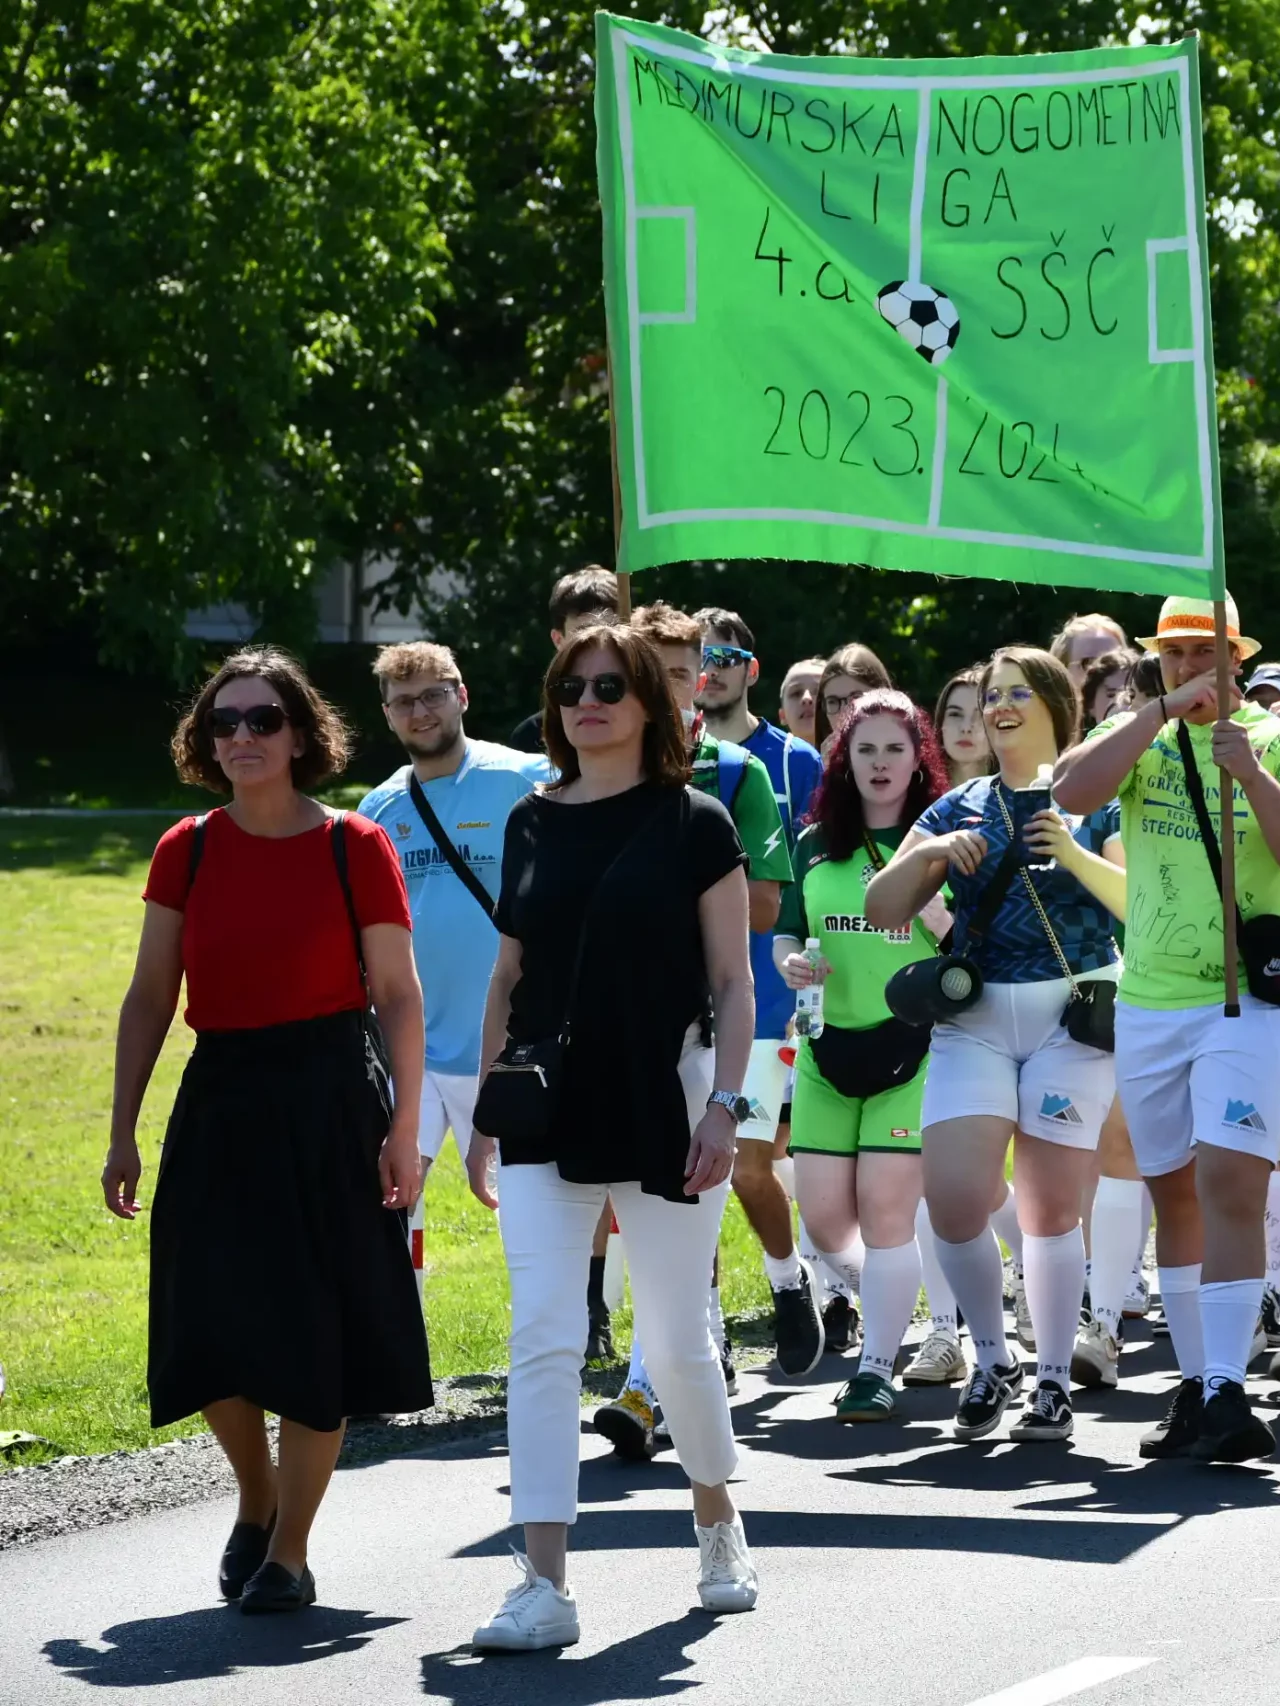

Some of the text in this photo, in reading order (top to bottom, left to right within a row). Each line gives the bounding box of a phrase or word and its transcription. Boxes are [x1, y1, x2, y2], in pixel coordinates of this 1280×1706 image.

[936, 78, 1182, 159] NOGOMETNA
[754, 207, 1119, 341] 4.a SŠČ
[762, 385, 924, 476] 2023.
